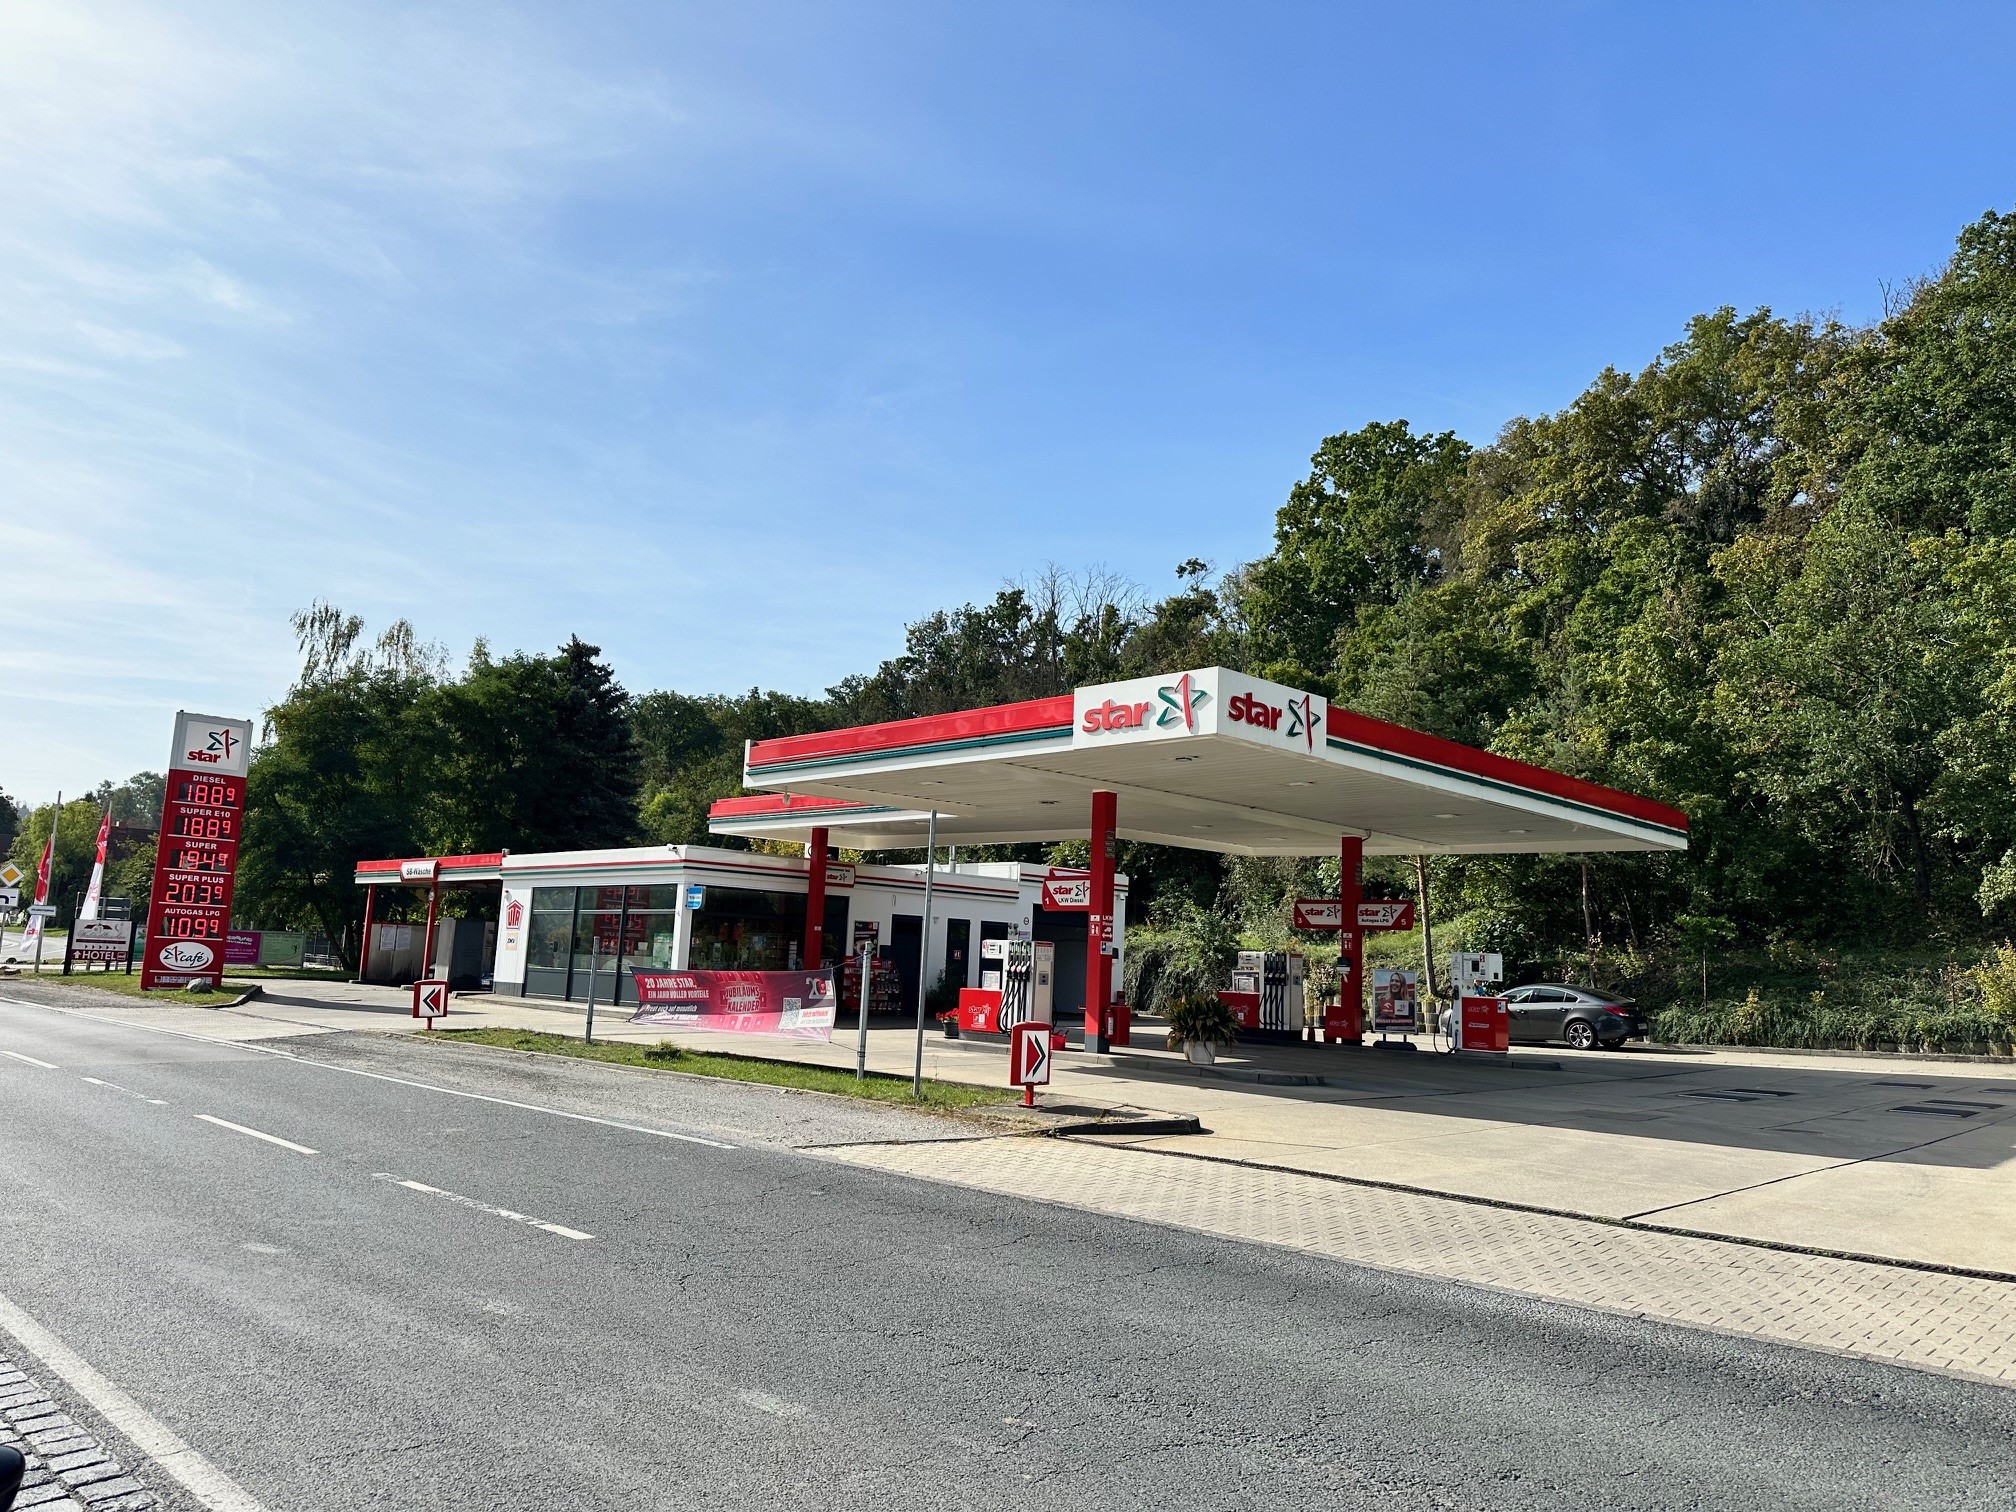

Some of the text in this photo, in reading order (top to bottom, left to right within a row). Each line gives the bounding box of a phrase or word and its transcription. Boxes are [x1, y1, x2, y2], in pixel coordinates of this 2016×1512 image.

[1082, 698, 1150, 732] star
[1228, 692, 1282, 732] star
[187, 750, 221, 762] star
[193, 774, 226, 784] DIESEL
[180, 807, 212, 816] SUPER
[185, 841, 217, 850] SUPER
[406, 867, 431, 875] SB-Wäsche
[169, 874, 199, 882] SUPER
[1052, 885, 1073, 895] star
[508, 906, 520, 927] UTA
[1359, 908, 1380, 917] star
[82, 950, 116, 960] HOTEL
[180, 952, 204, 966] café
[645, 978, 655, 988] 20
[656, 978, 676, 988] JAHRE
[657, 990, 669, 998] JAHR
[670, 990, 687, 998] VOLLER
[688, 990, 709, 998] VORTEILE
[727, 1000, 760, 1012] KALENDER
[969, 1005, 982, 1014] star
